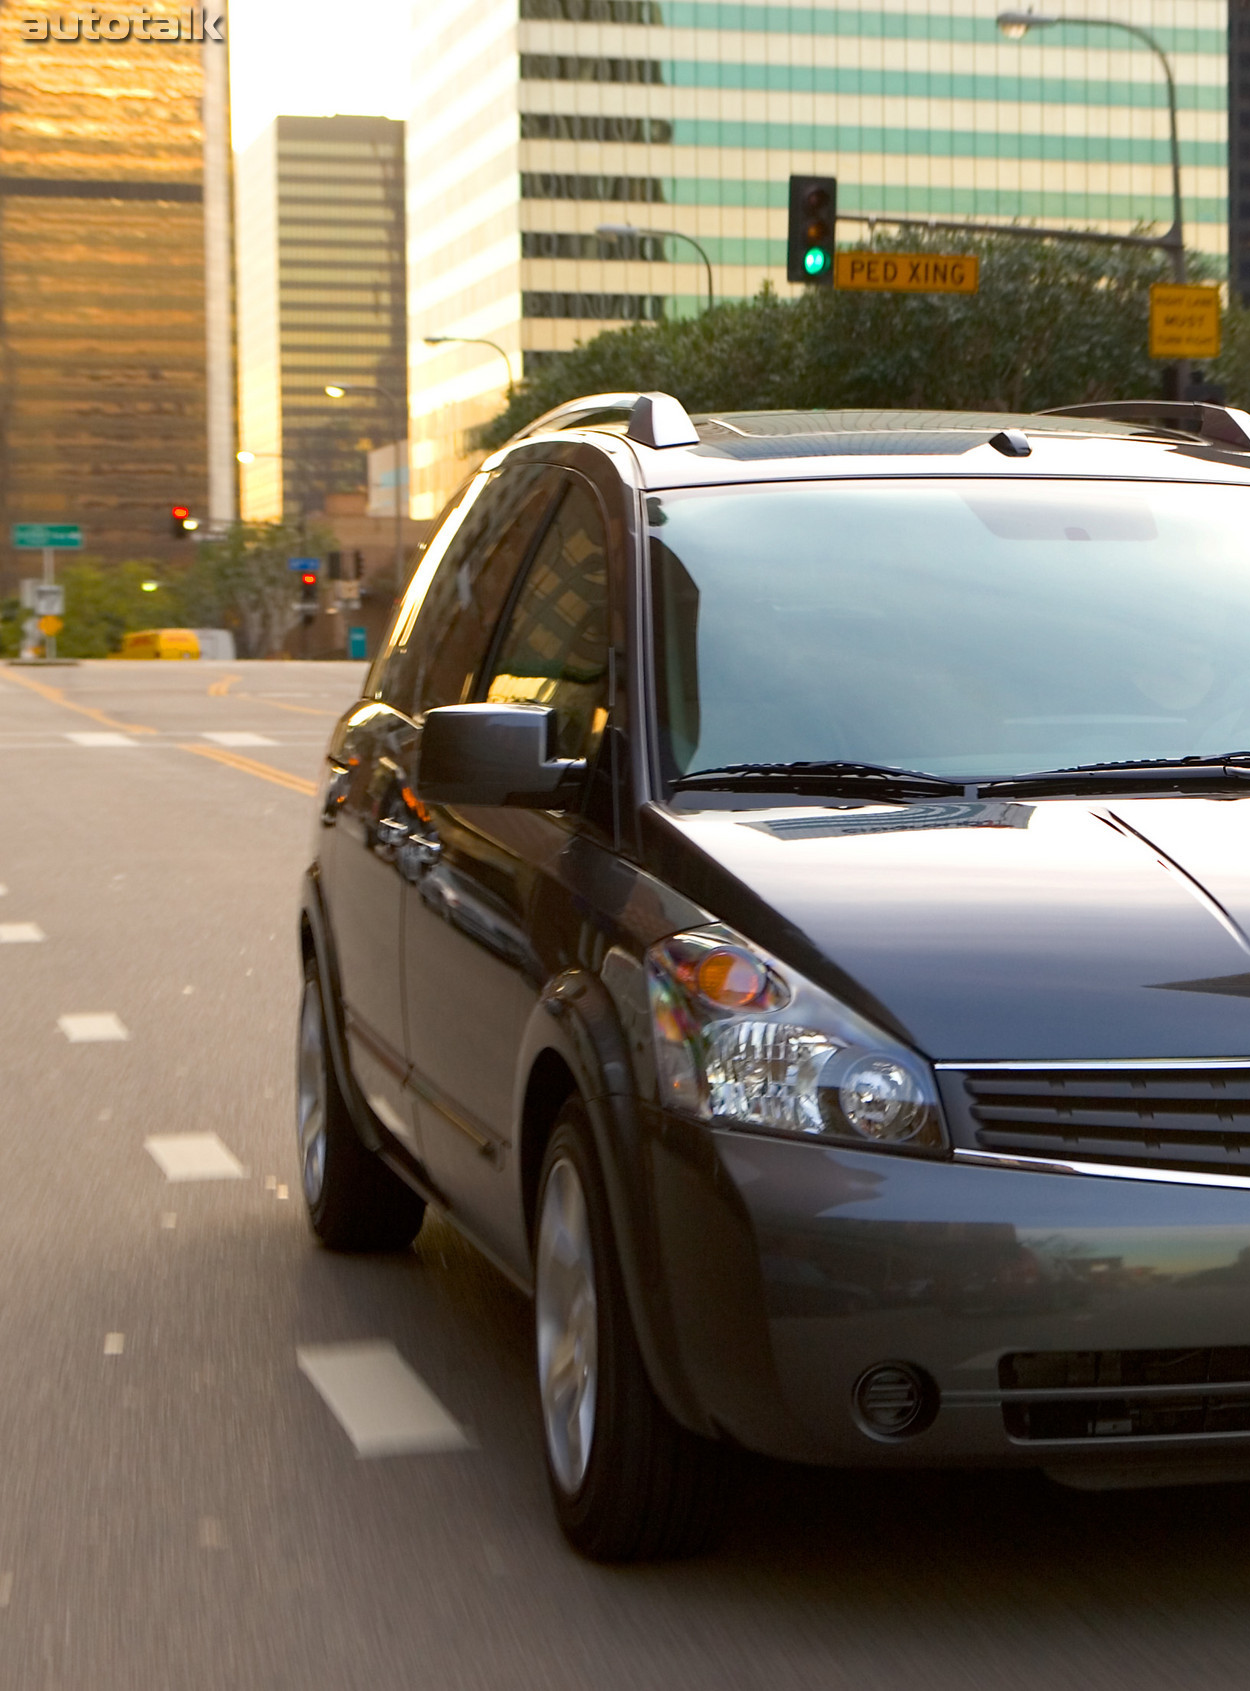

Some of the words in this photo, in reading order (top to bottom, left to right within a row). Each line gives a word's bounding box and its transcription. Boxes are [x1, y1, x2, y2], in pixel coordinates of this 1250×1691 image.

[850, 260, 898, 284] PED
[907, 261, 965, 286] XING
[1164, 313, 1206, 328] MUST
